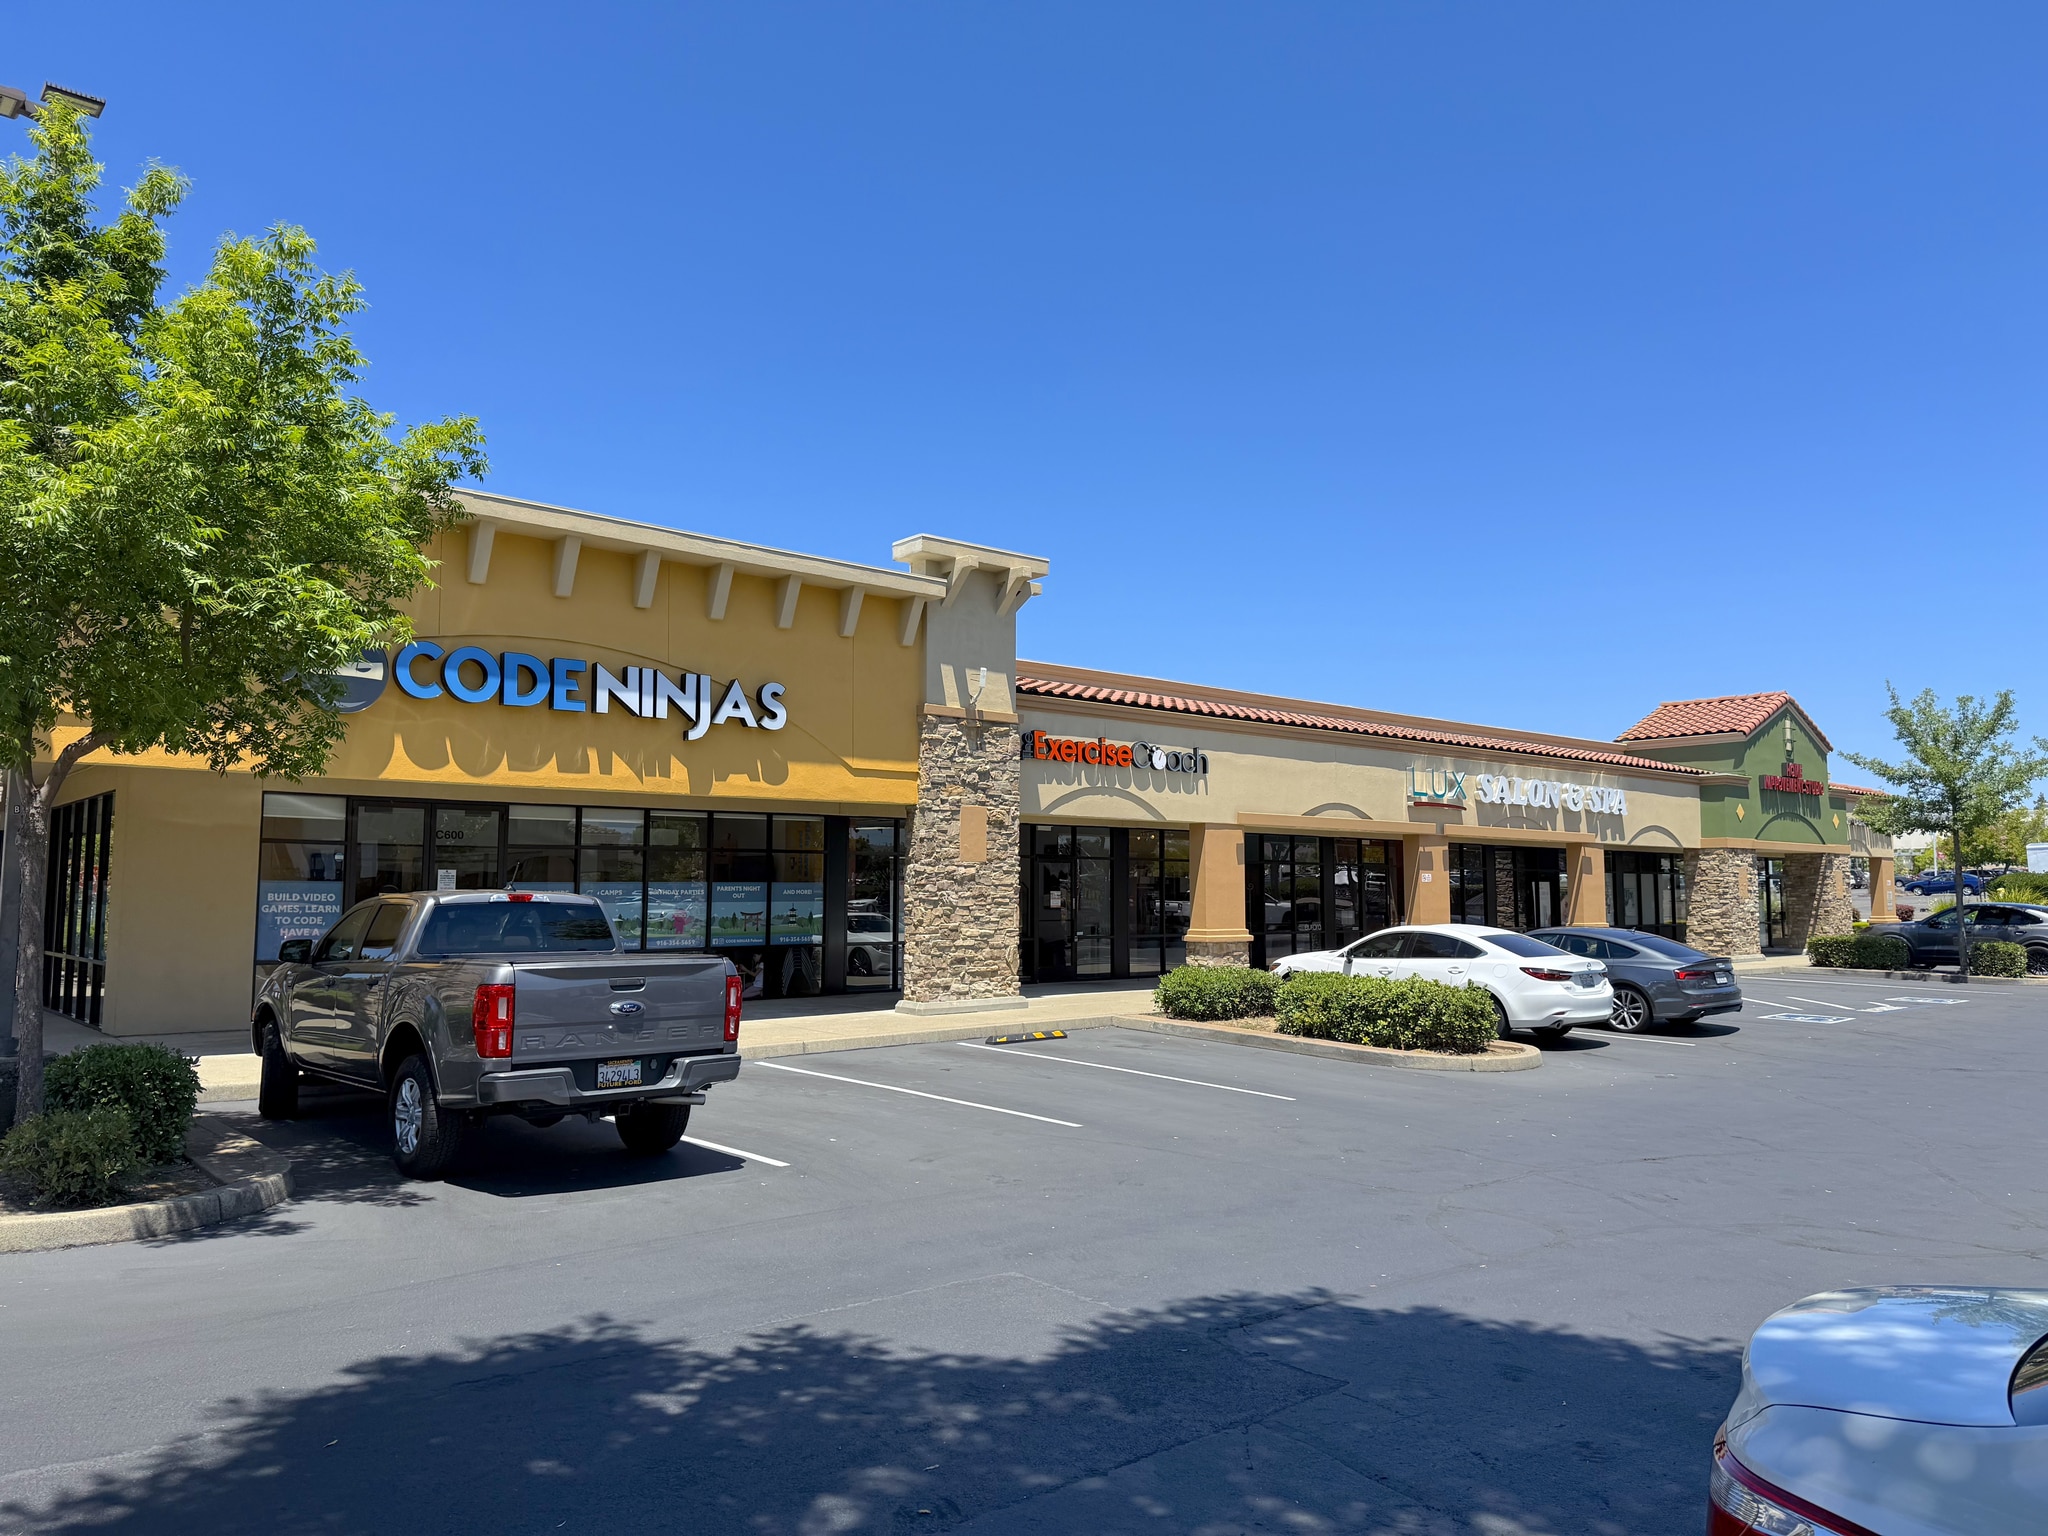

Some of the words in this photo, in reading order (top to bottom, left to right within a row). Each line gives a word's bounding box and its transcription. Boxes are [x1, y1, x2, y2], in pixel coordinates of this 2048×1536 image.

[394, 641, 587, 713] CODE
[592, 661, 787, 741] NINJAS
[1033, 730, 1133, 767] Exercise
[1131, 740, 1209, 775] Coach
[1785, 762, 1803, 779] HOME
[1409, 766, 1467, 800] LUX
[1476, 773, 1562, 809] SALON
[1562, 782, 1585, 812] &
[1584, 785, 1628, 816] SPA
[436, 830, 464, 839] C600
[267, 892, 300, 902] BUILD
[302, 893, 336, 902] VIDEO
[261, 904, 302, 914] GAMES,
[305, 905, 340, 913] LEARN
[274, 916, 291, 925] TO
[293, 916, 326, 926] CODE,
[280, 928, 310, 937] HAVE
[312, 928, 320, 937] A
[520, 1025, 720, 1050] RANGER
[597, 1080, 623, 1089] FUTURE
[624, 1078, 643, 1087] FORD
